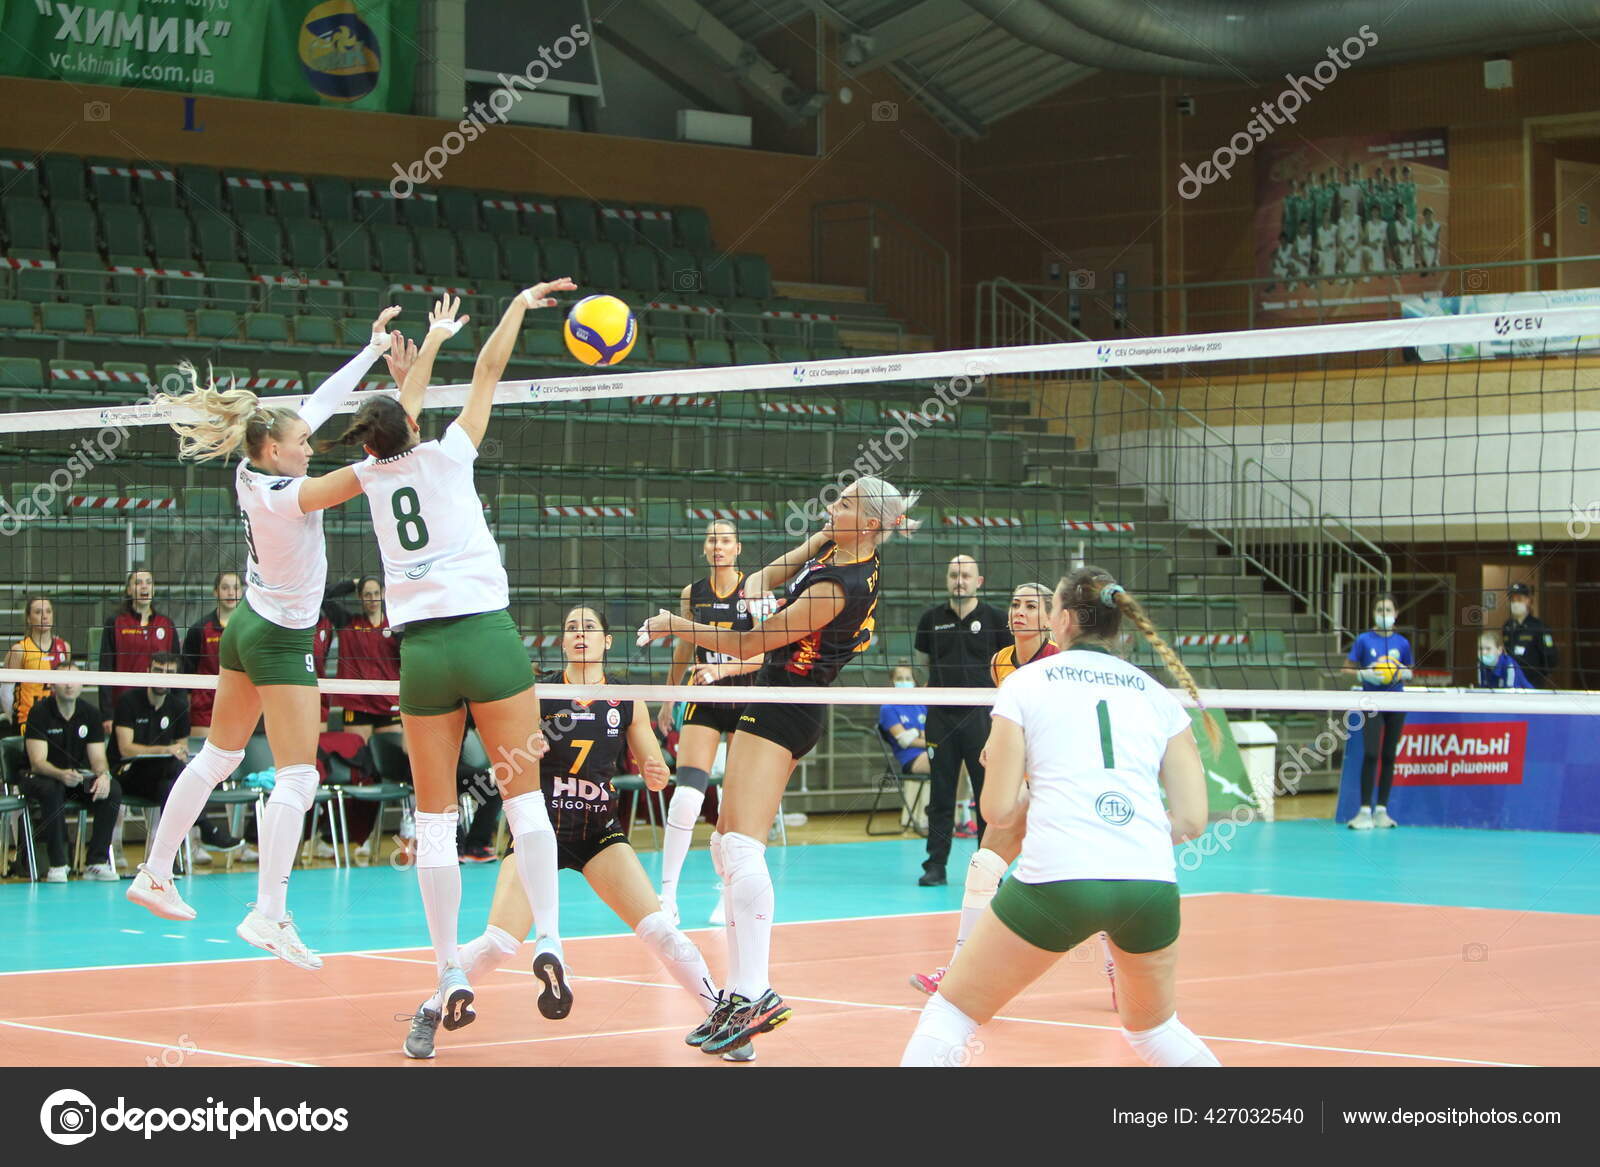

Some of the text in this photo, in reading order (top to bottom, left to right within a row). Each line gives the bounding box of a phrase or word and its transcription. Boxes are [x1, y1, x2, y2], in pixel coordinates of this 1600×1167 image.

[50, 52, 214, 84] vc.khimik.com.ua
[1513, 317, 1543, 330] CEV
[1115, 342, 1222, 357] CEV Champions League Volley 2020
[808, 364, 902, 377] CEV Champions League Volley 2020
[553, 384, 579, 393] Champions
[579, 383, 596, 392] League
[392, 487, 429, 551] 8
[305, 653, 315, 672] 9
[1045, 666, 1146, 691] KYRYCHENKO
[1096, 700, 1115, 769] 1
[569, 740, 594, 774] 7
[1451, 760, 1508, 778] рішення
